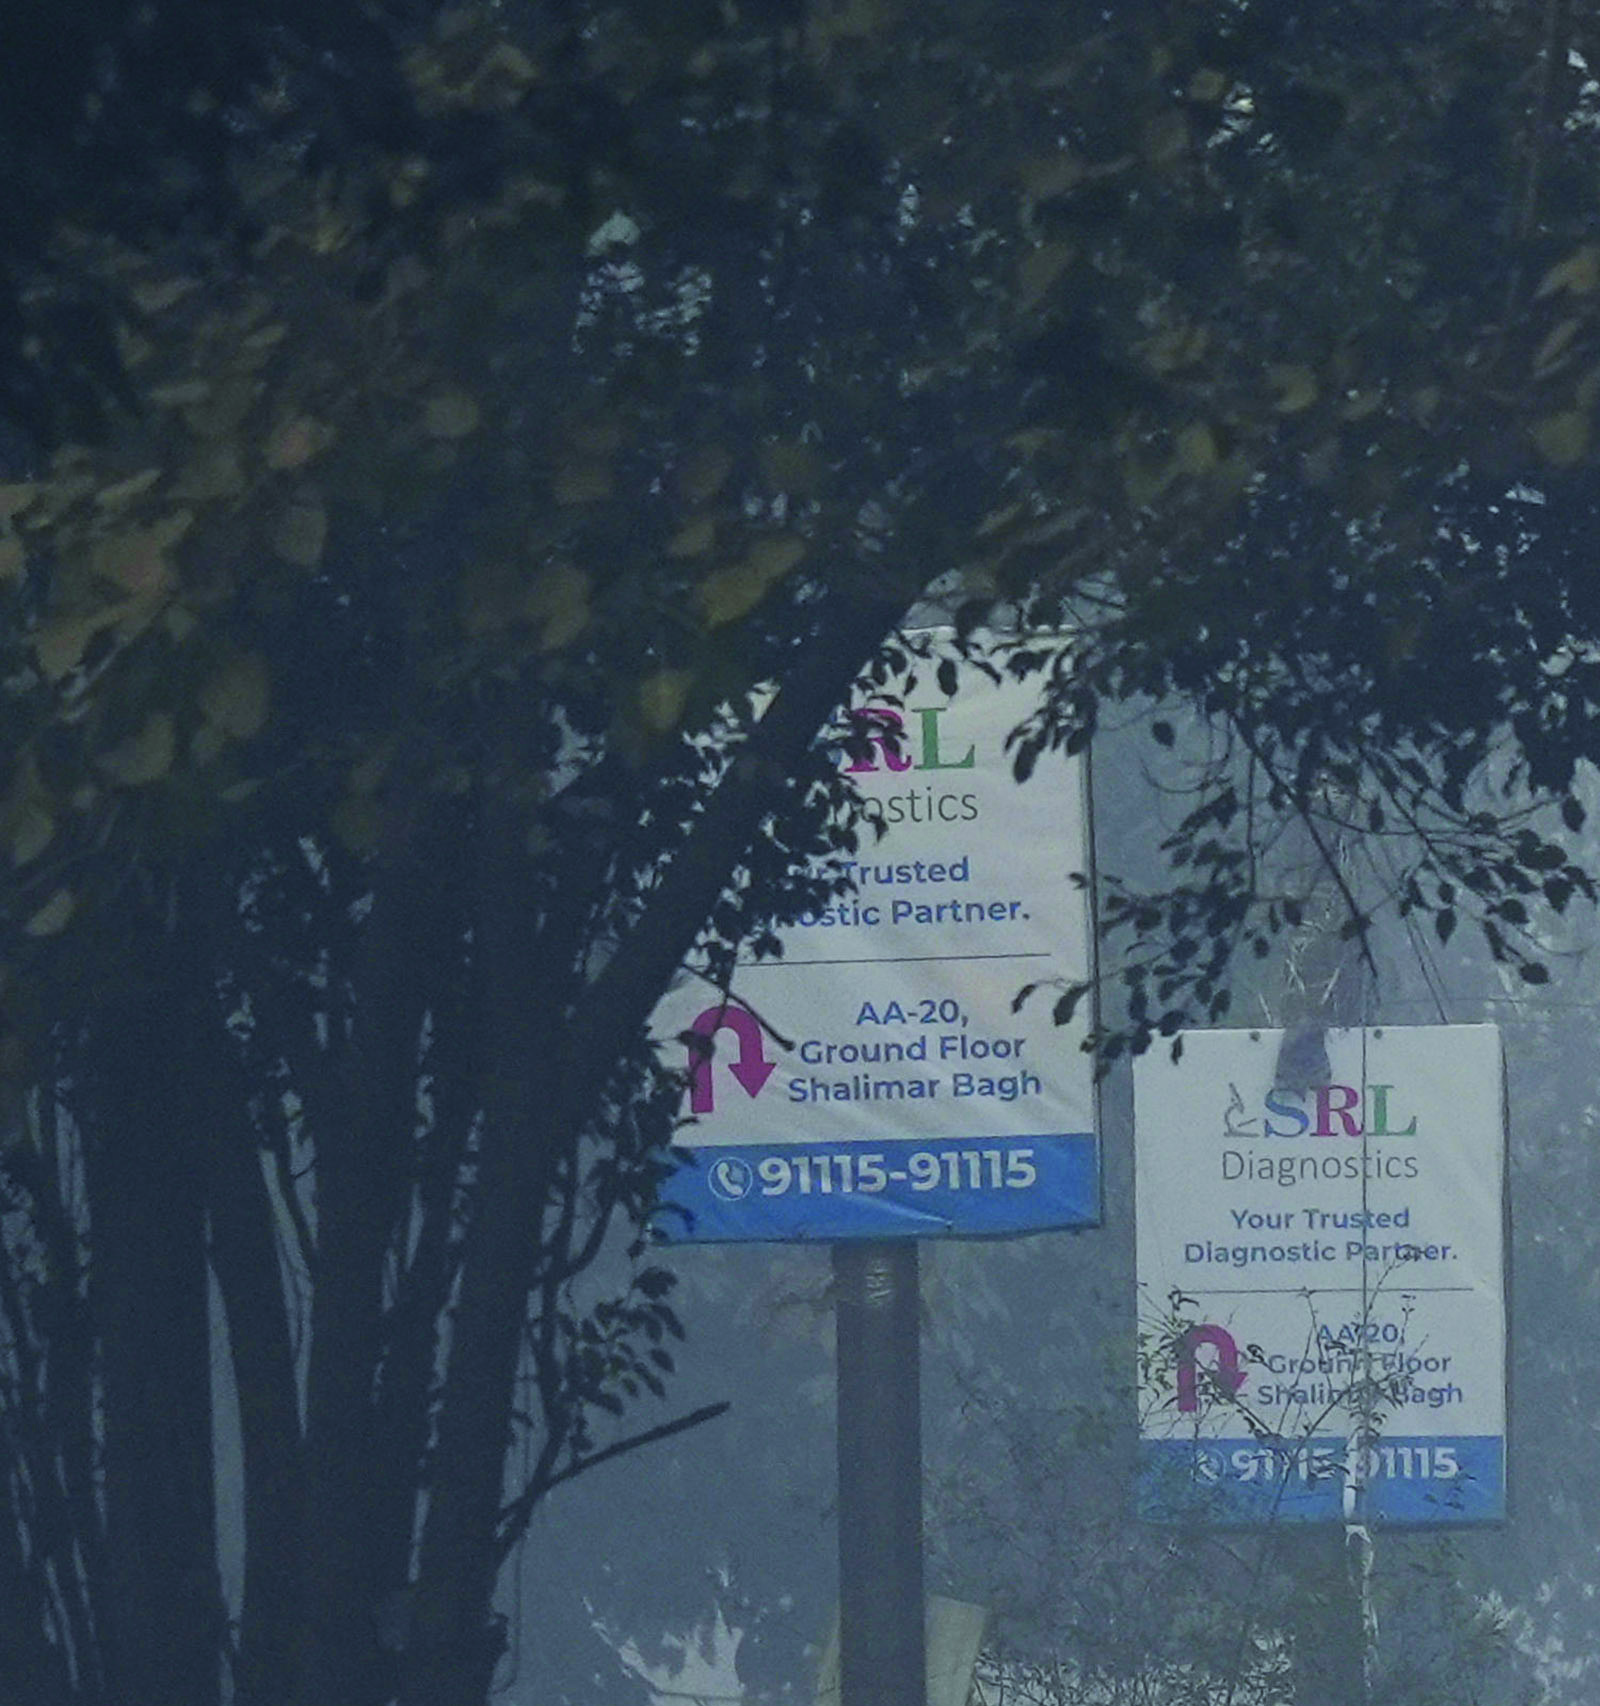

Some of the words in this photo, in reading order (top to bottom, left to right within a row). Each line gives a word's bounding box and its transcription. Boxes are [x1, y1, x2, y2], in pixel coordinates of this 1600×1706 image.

[815, 706, 976, 773] RL
[838, 856, 970, 885] Trusted
[891, 900, 1030, 925] Partner.
[856, 999, 969, 1028] AA-20,
[799, 1035, 927, 1065] Ground
[939, 1033, 1027, 1061] Floor
[788, 1071, 941, 1103] Shalimar
[952, 1069, 1042, 1101] Bagh
[1264, 1084, 1418, 1139] SRL
[758, 1149, 1037, 1196] 91115-91115
[1222, 1150, 1419, 1187] Diagnostics
[1230, 1208, 1295, 1230] Your
[1302, 1206, 1410, 1230] Trusted
[1184, 1239, 1337, 1268] Diagnostic
[1268, 1354, 1372, 1375] Groun
[1257, 1381, 1380, 1405] Shali
